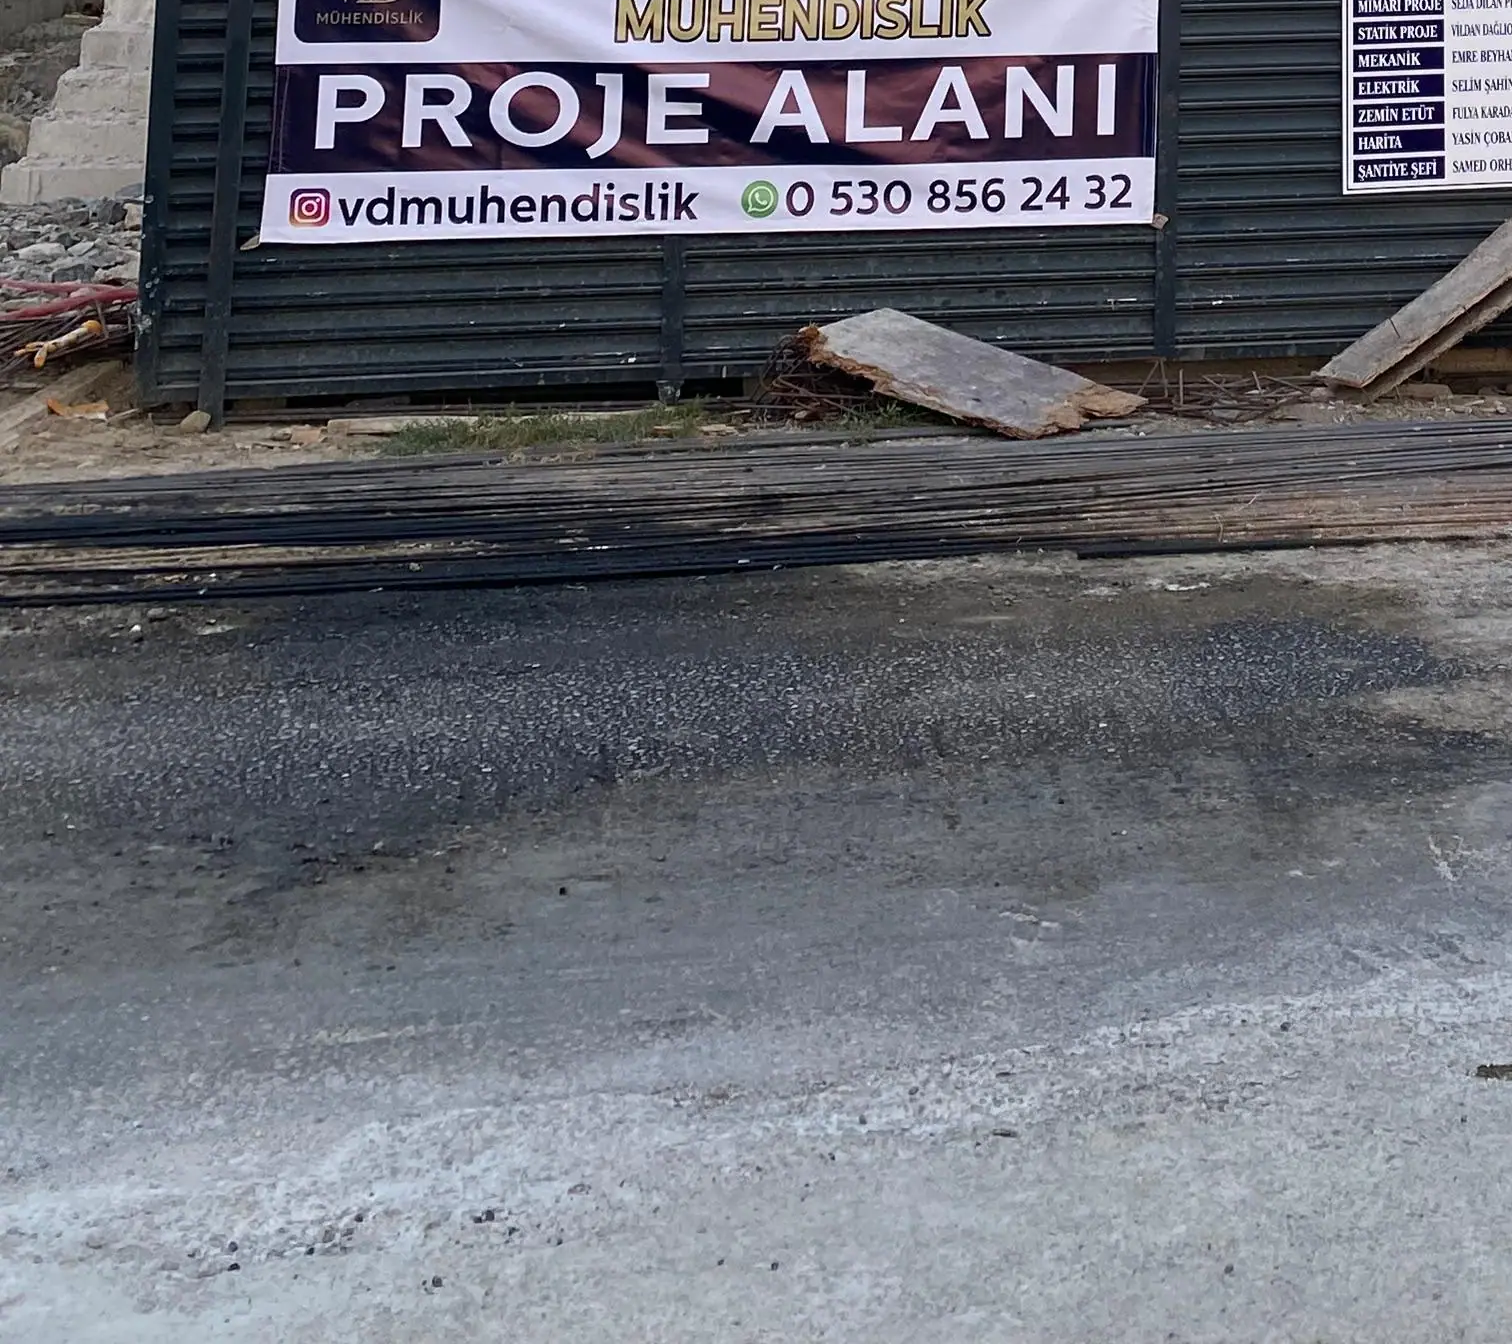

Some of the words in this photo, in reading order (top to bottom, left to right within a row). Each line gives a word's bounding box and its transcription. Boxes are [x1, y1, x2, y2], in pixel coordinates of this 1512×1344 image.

[316, 9, 423, 25] MÜHENDİSLİK
[1358, 23, 1397, 40] STATİK
[1400, 25, 1437, 39] PROJE
[1451, 21, 1480, 37] VİLDAN
[1358, 50, 1420, 68] MEKANİK
[1452, 50, 1478, 63] EMRE
[1358, 77, 1420, 95] ELEKTRİK
[1452, 76, 1481, 92] SELİM
[314, 71, 709, 159] PROJE
[750, 64, 1117, 144] ALANI
[1358, 106, 1398, 123] ZEMİN
[1402, 104, 1435, 121] ETÜT
[1452, 106, 1479, 119] FULYA
[1358, 133, 1402, 150] HARİTA
[1452, 129, 1480, 145] YASİN
[1358, 161, 1408, 181] ŞANTİYE
[1410, 159, 1437, 178] ŞEFİ
[1452, 160, 1487, 173] SAMED
[338, 182, 699, 226] vdmuhendislik
[785, 181, 815, 218] 0
[830, 179, 912, 215] 530
[927, 177, 1006, 213] 856
[1020, 176, 1070, 211] 24
[1084, 174, 1132, 209] 32
